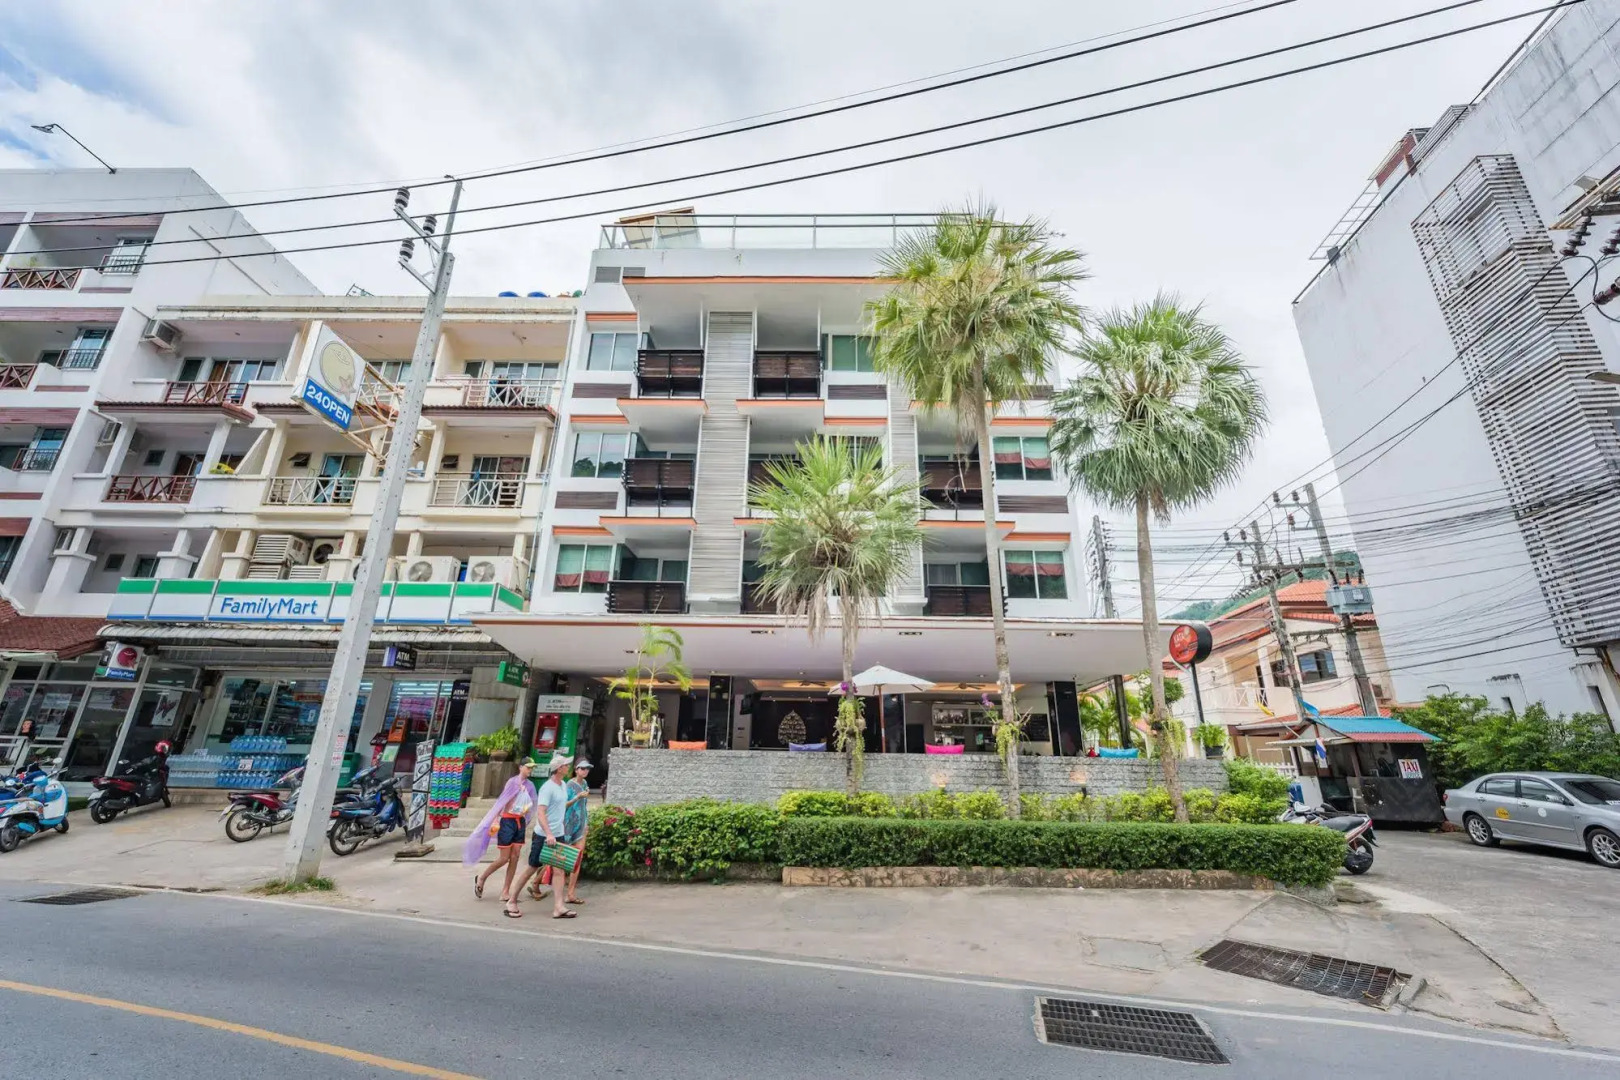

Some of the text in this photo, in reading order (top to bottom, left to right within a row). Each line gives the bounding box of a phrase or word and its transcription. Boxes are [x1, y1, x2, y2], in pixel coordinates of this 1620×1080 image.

[306, 385, 350, 424] 24OPEN
[221, 597, 318, 618] FamilyMart
[397, 651, 410, 660] ATM
[1402, 761, 1419, 772] TAXI
